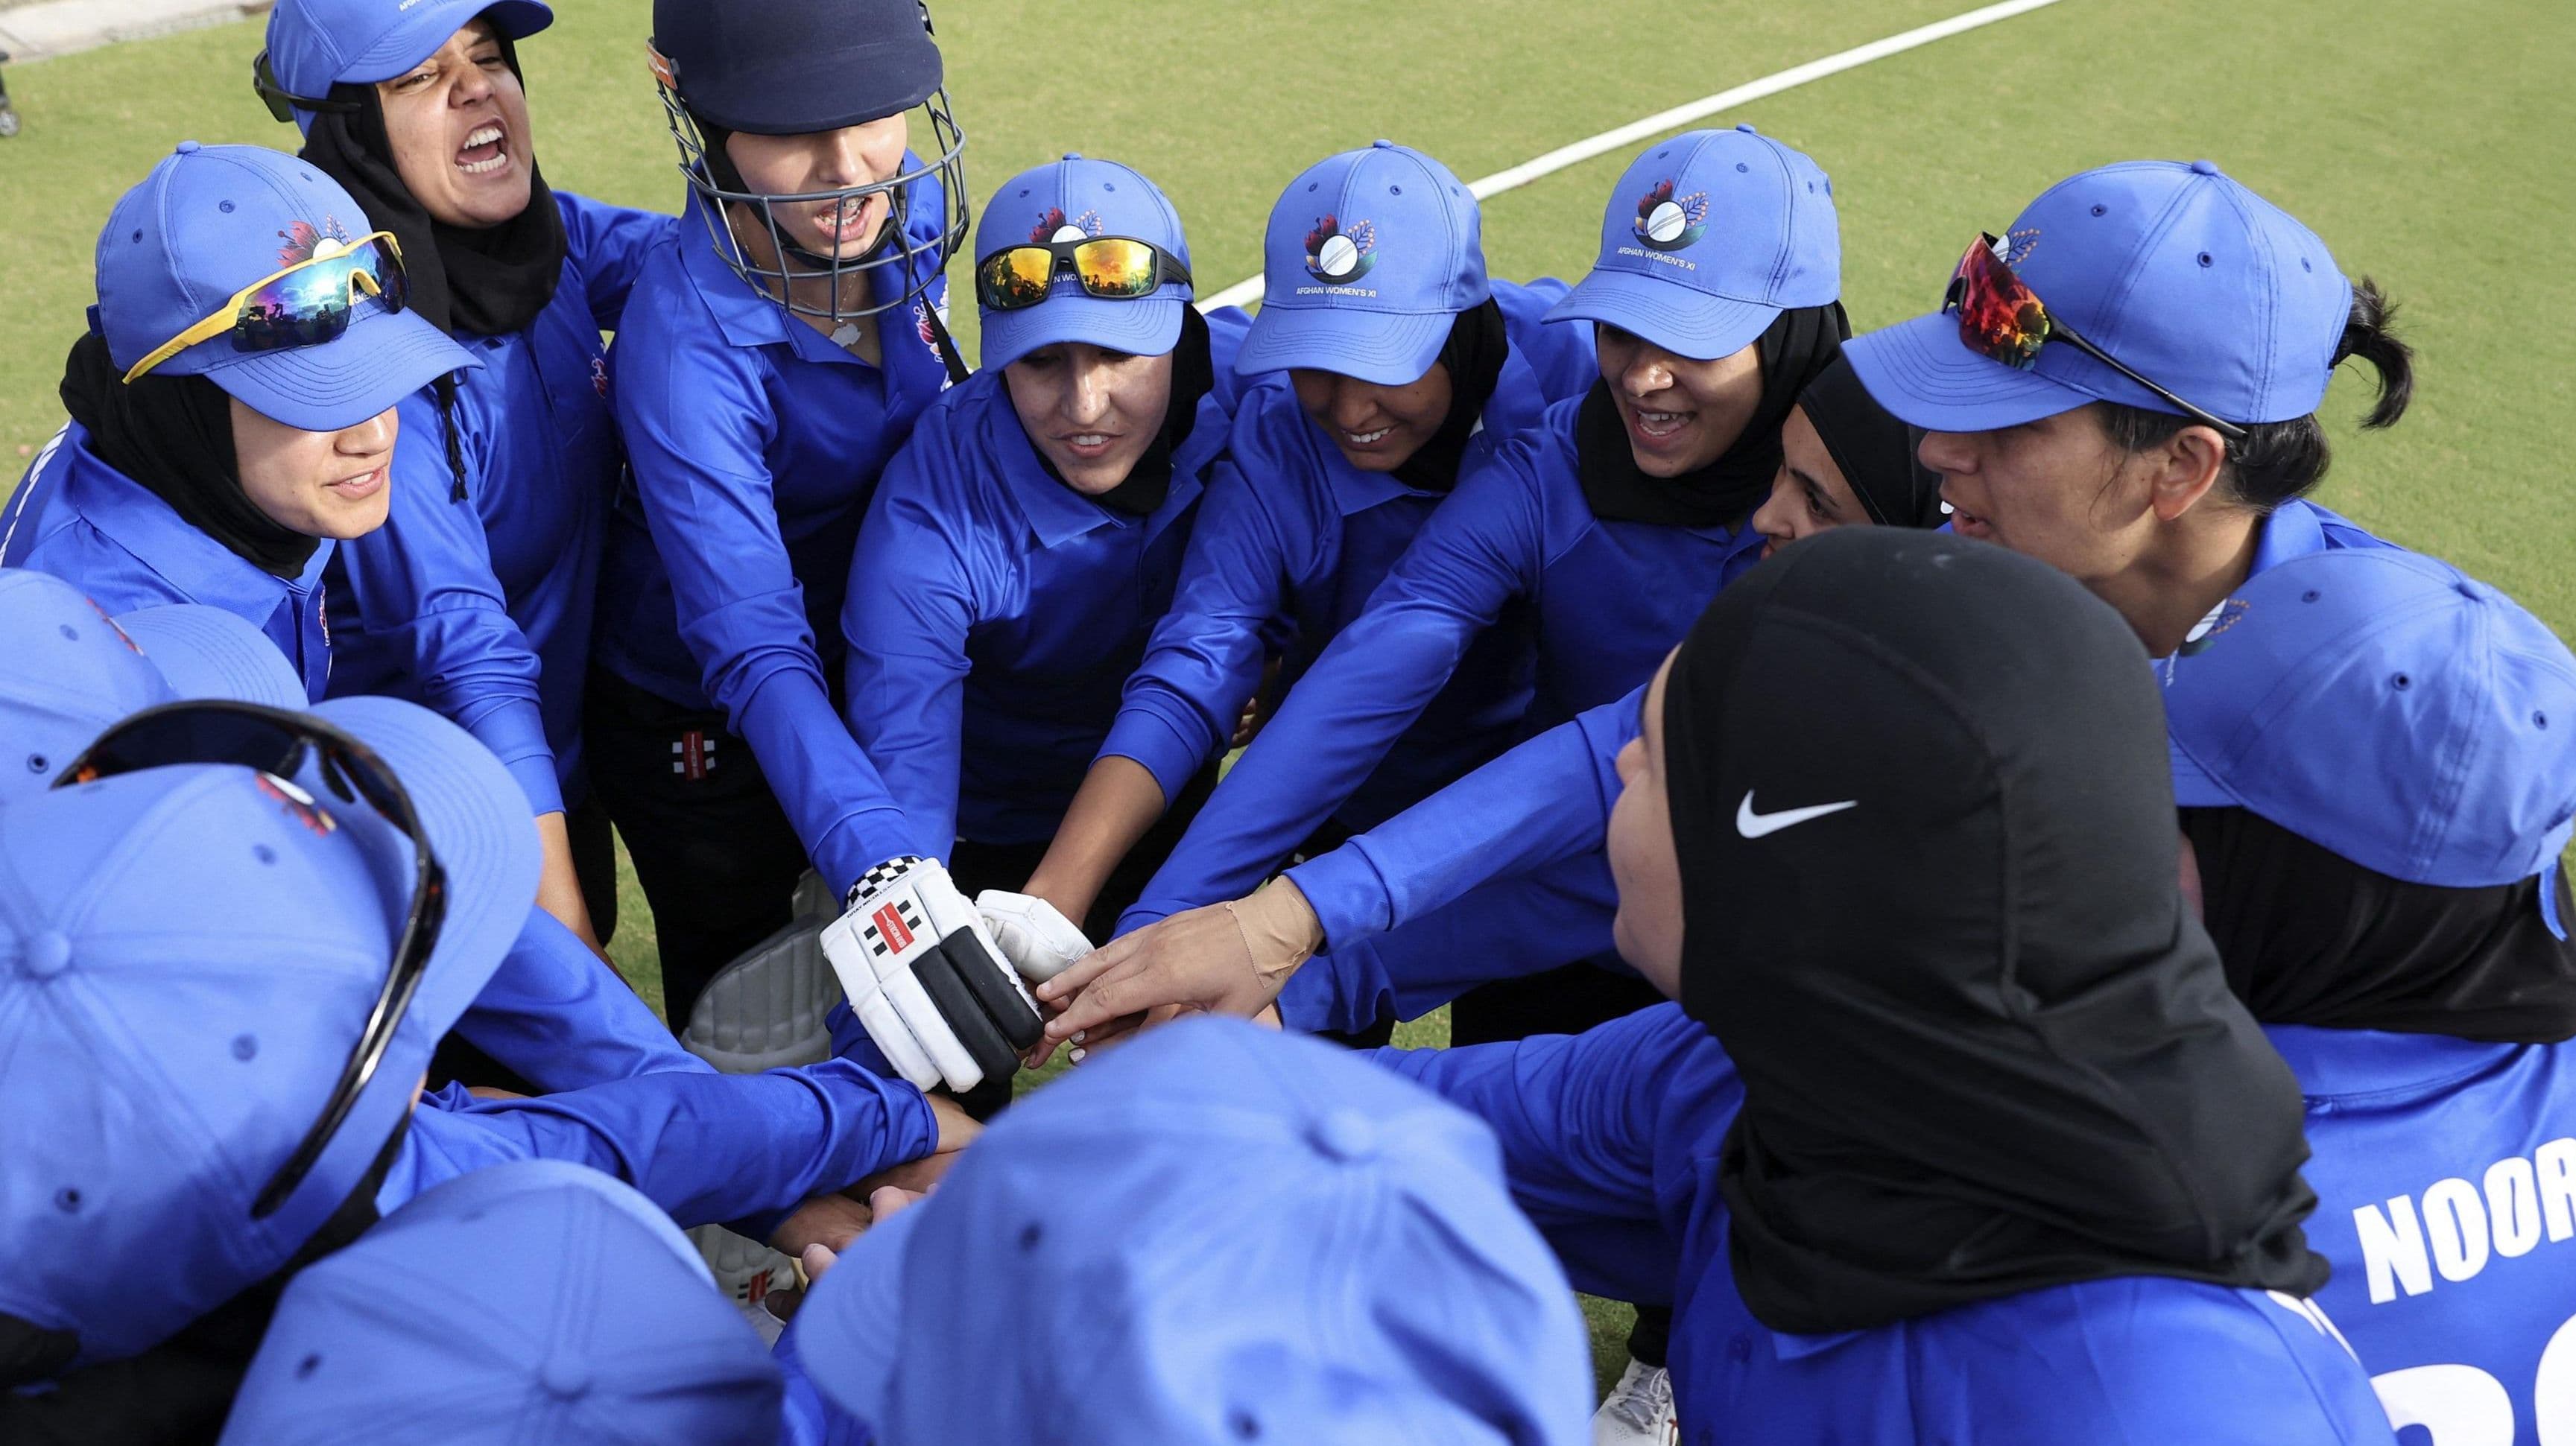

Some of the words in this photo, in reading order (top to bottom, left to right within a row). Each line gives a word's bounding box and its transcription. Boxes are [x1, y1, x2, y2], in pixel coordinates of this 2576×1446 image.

[1617, 247, 1645, 258] AFGHAN
[1645, 250, 1686, 267] WOMEN'S
[1686, 261, 1696, 271] XI
[1296, 286, 1324, 295] AFGHAN
[1325, 286, 1367, 297] WOMEN'S
